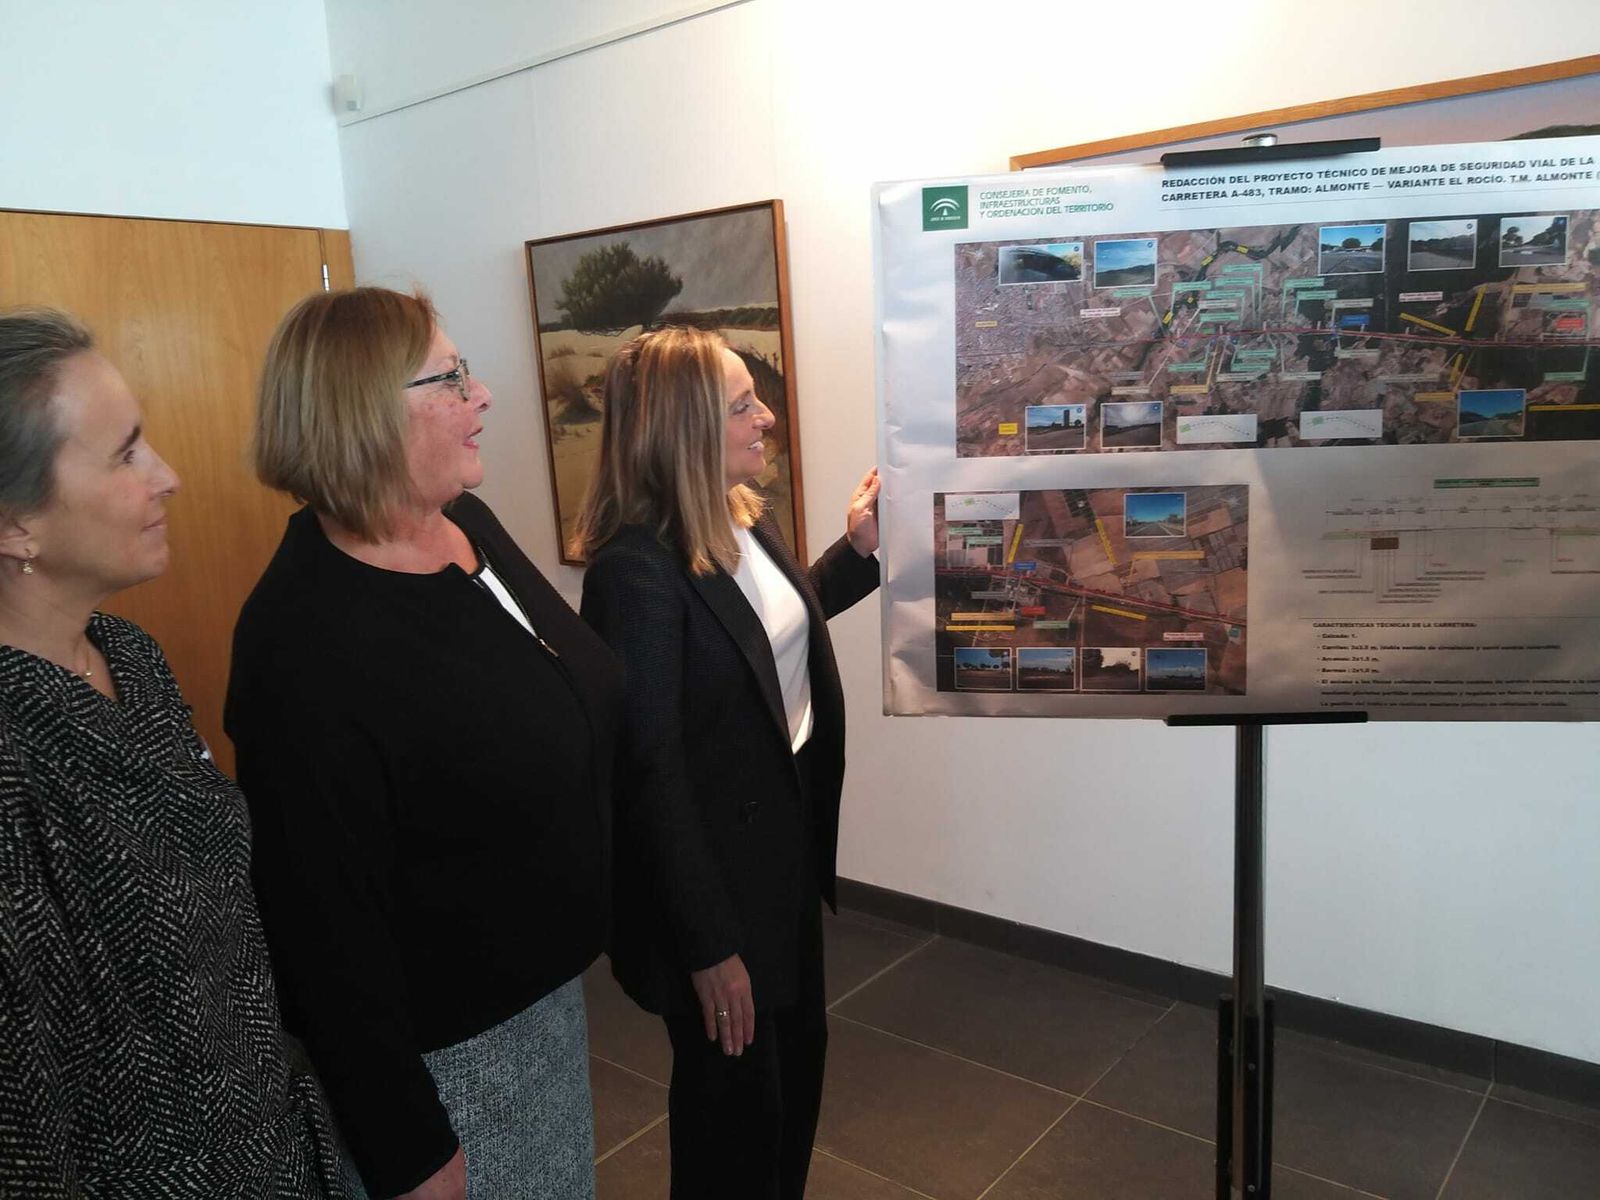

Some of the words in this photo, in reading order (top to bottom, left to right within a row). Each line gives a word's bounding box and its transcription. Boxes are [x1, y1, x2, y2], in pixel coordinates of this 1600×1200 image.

[1162, 175, 1225, 188] REDACCIÓN
[1229, 175, 1250, 184] DEL
[1254, 171, 1313, 182] PROYECTO
[1317, 167, 1368, 179] TÉCNICO
[1371, 167, 1386, 176] DE
[1389, 164, 1437, 175] MEJORA
[1441, 163, 1456, 172] DE
[1459, 160, 1526, 171] SEGURIDAD
[1529, 159, 1556, 168] VIAL
[1560, 157, 1576, 167] DE
[1579, 156, 1594, 165] LA
[1032, 187, 1044, 197] DE
[1047, 185, 1092, 196] FOMENTO,
[1161, 190, 1228, 202] CARRETERA
[1231, 188, 1265, 198] A-483,
[1269, 185, 1312, 196] TRAMO:
[1315, 181, 1370, 193] ALMONTE
[1387, 177, 1446, 189] VARIANTE
[1449, 177, 1463, 186] EL
[1510, 174, 1532, 184] T.M.
[1535, 170, 1593, 182] ALMONTE
[979, 197, 1060, 209] INFRAESTRUCTURAS
[1046, 205, 1062, 214] DEL
[1064, 202, 1114, 213] TERRITORIO
